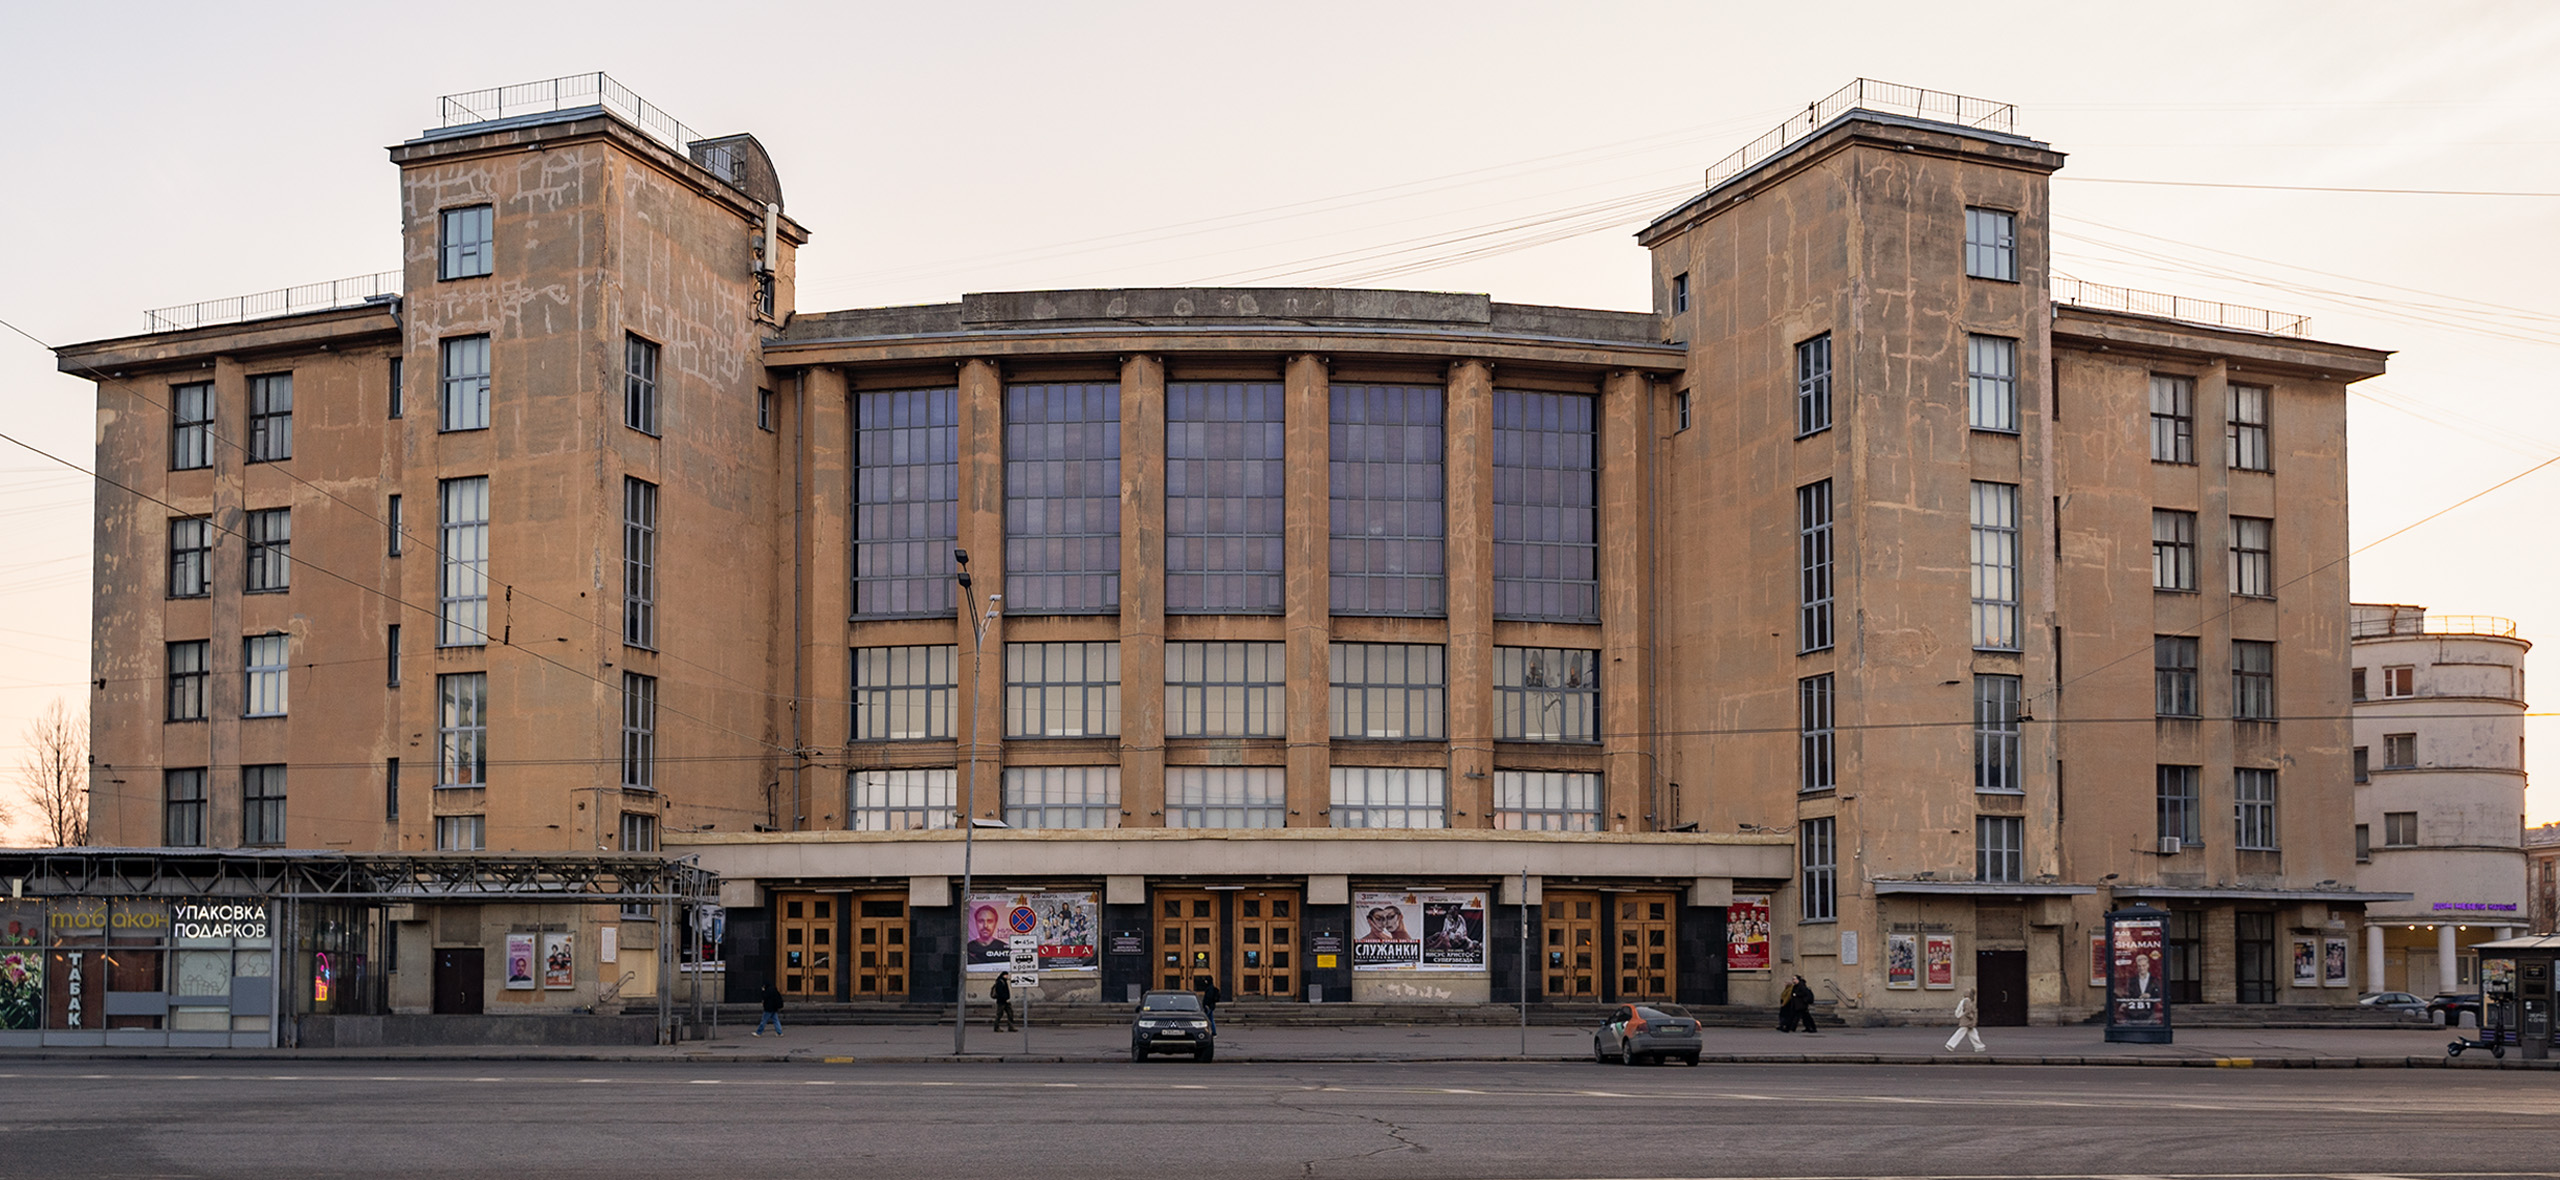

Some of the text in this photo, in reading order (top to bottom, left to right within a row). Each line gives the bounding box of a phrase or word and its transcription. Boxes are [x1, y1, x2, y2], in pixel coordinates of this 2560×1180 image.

[175, 905, 266, 920] УПАКОВКА
[174, 923, 266, 939] ПОДАРКОВ
[1355, 944, 1418, 956] СЛУЖАНКИ
[2115, 941, 2161, 949] SHAMAN
[68, 952, 82, 1026] ТАБАК
